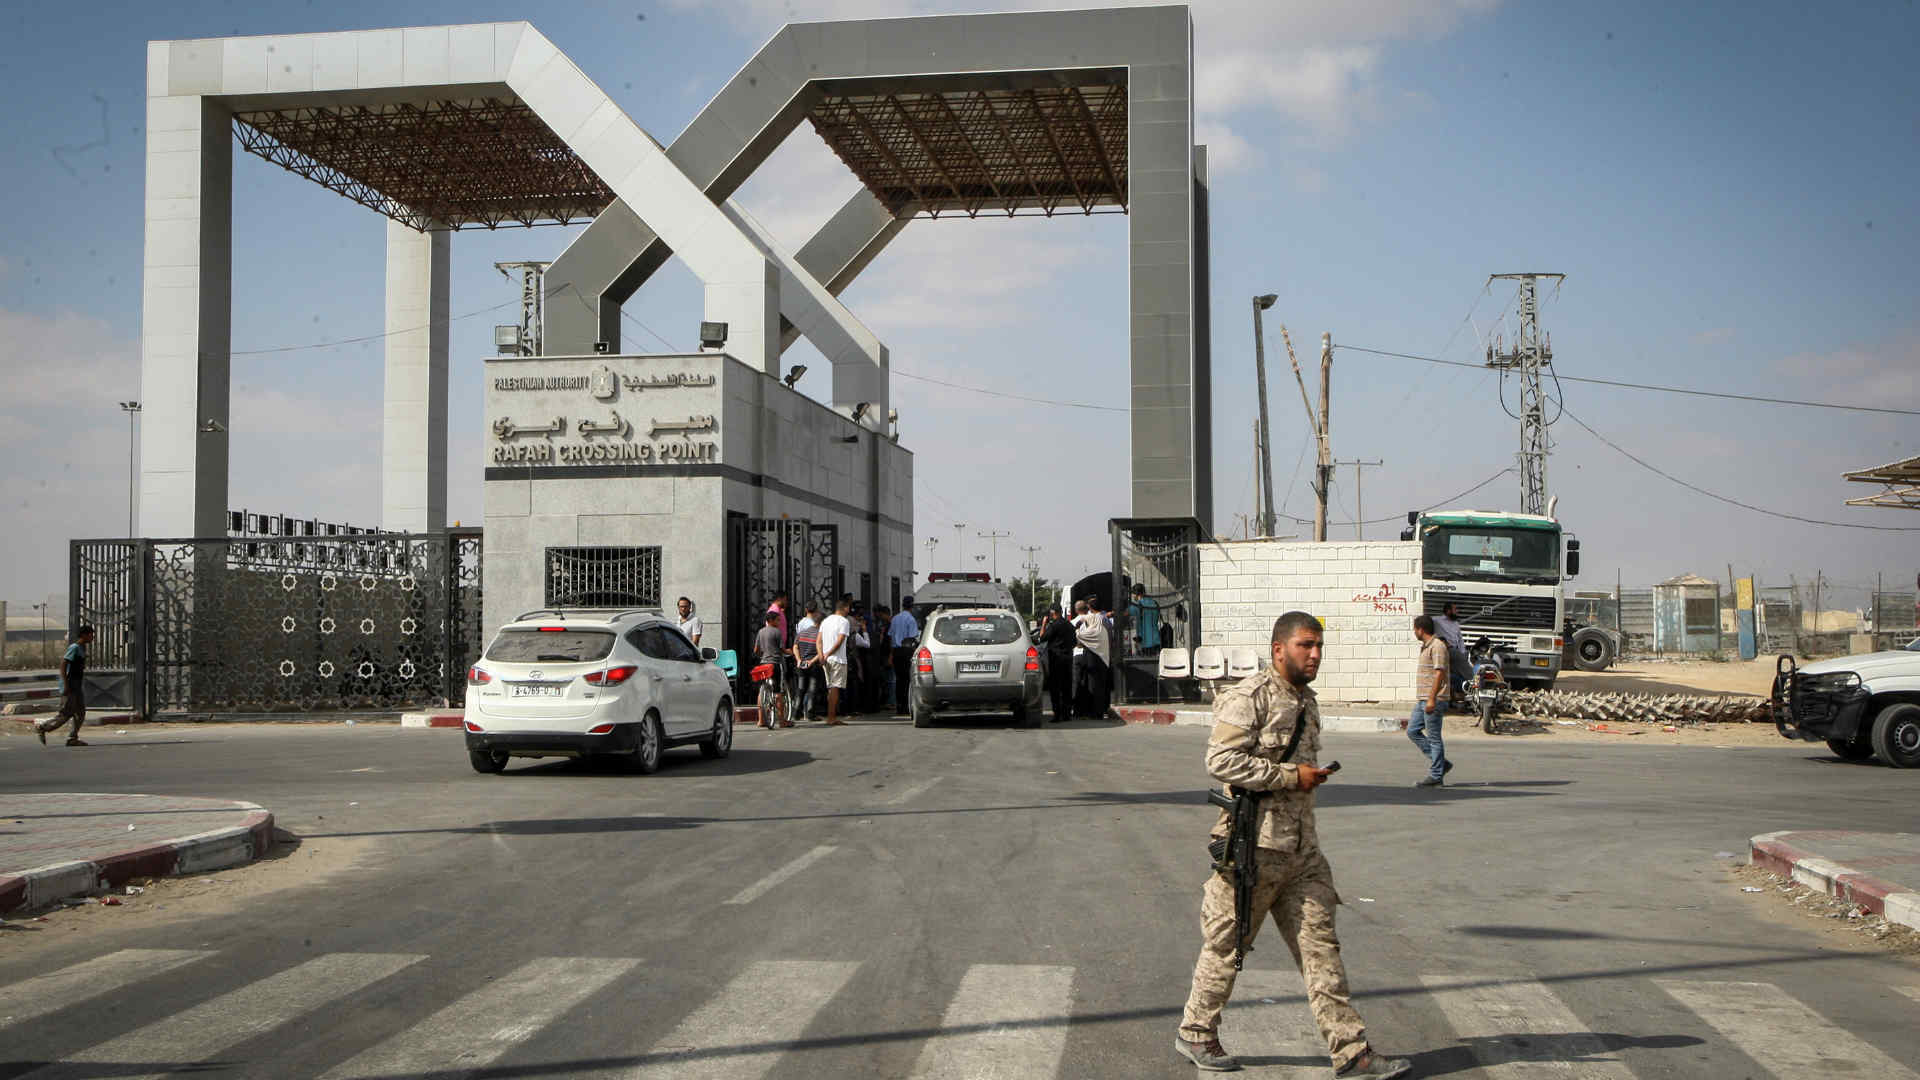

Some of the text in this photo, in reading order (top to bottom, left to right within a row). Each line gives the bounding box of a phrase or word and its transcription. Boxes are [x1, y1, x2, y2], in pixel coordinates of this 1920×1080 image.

[495, 375, 591, 391] PALESTINIAN AUTHORITY
[577, 410, 630, 439] رفح
[648, 415, 714, 438] معبر
[492, 440, 714, 464] RAFAH CROSSING POINT
